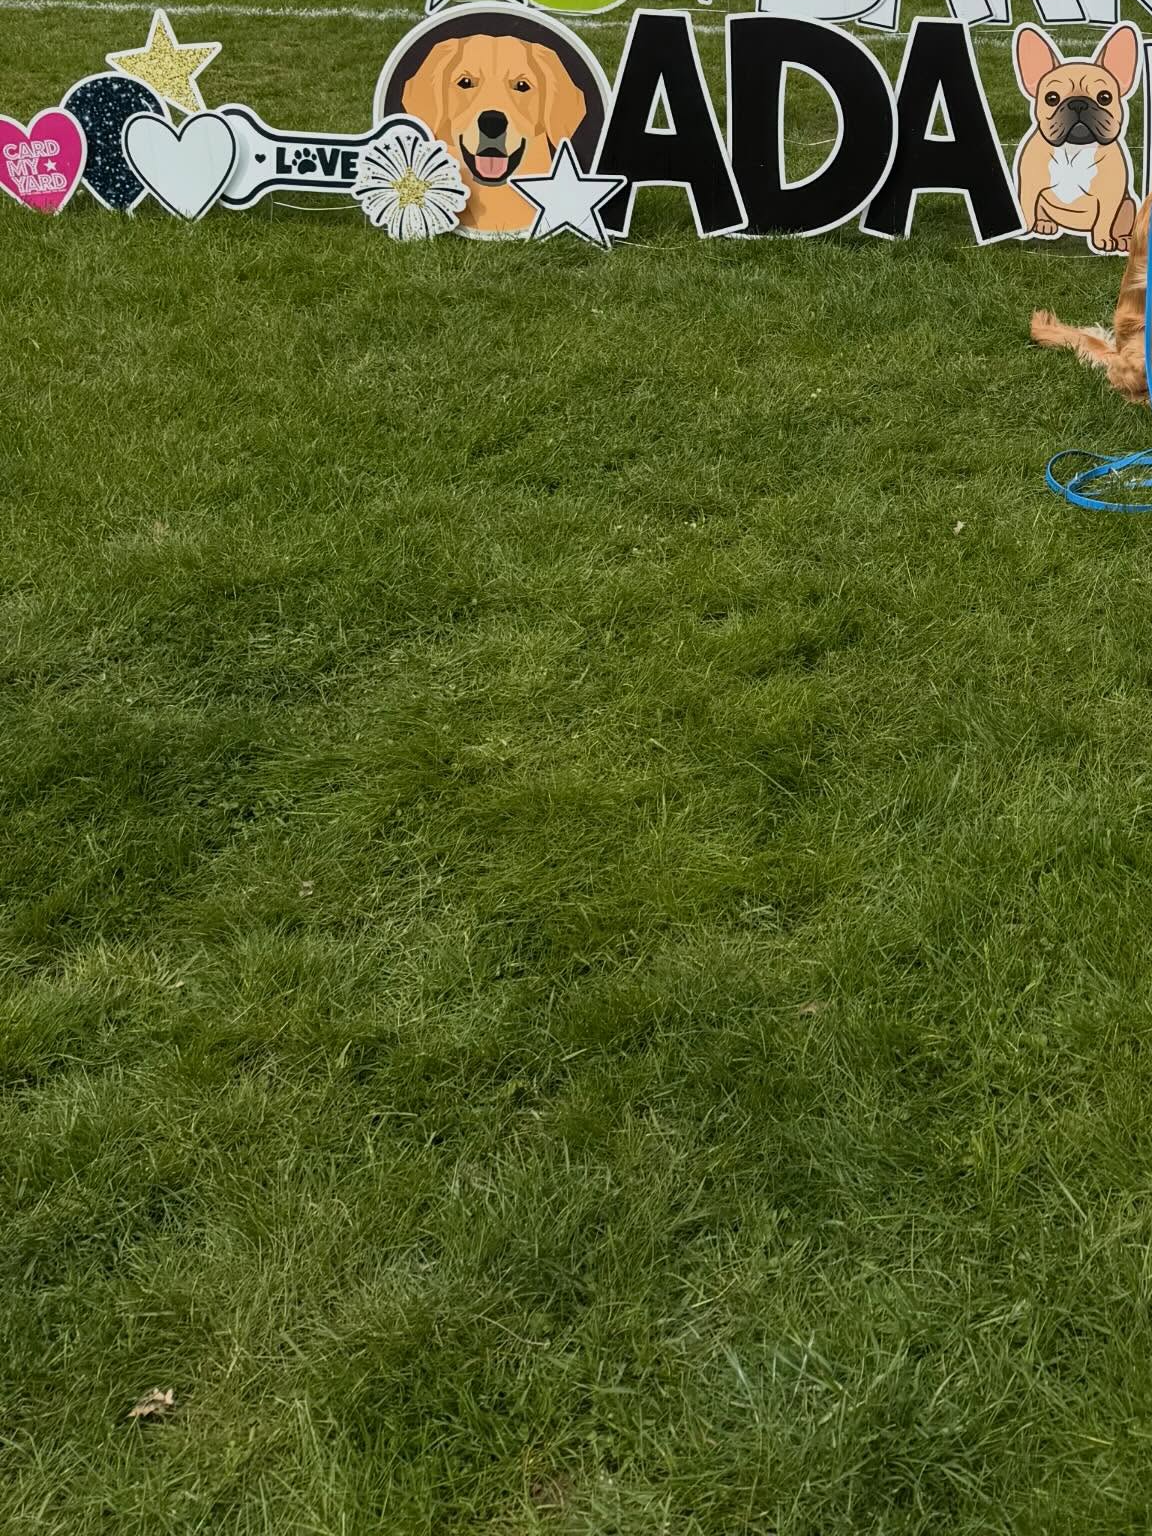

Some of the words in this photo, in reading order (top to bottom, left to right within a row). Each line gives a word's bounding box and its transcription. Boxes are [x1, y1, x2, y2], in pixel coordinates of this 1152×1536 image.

[594, 9, 1028, 245] ADA
[3, 139, 61, 160] CARD
[6, 157, 39, 177] MY
[11, 172, 68, 194] YARD
